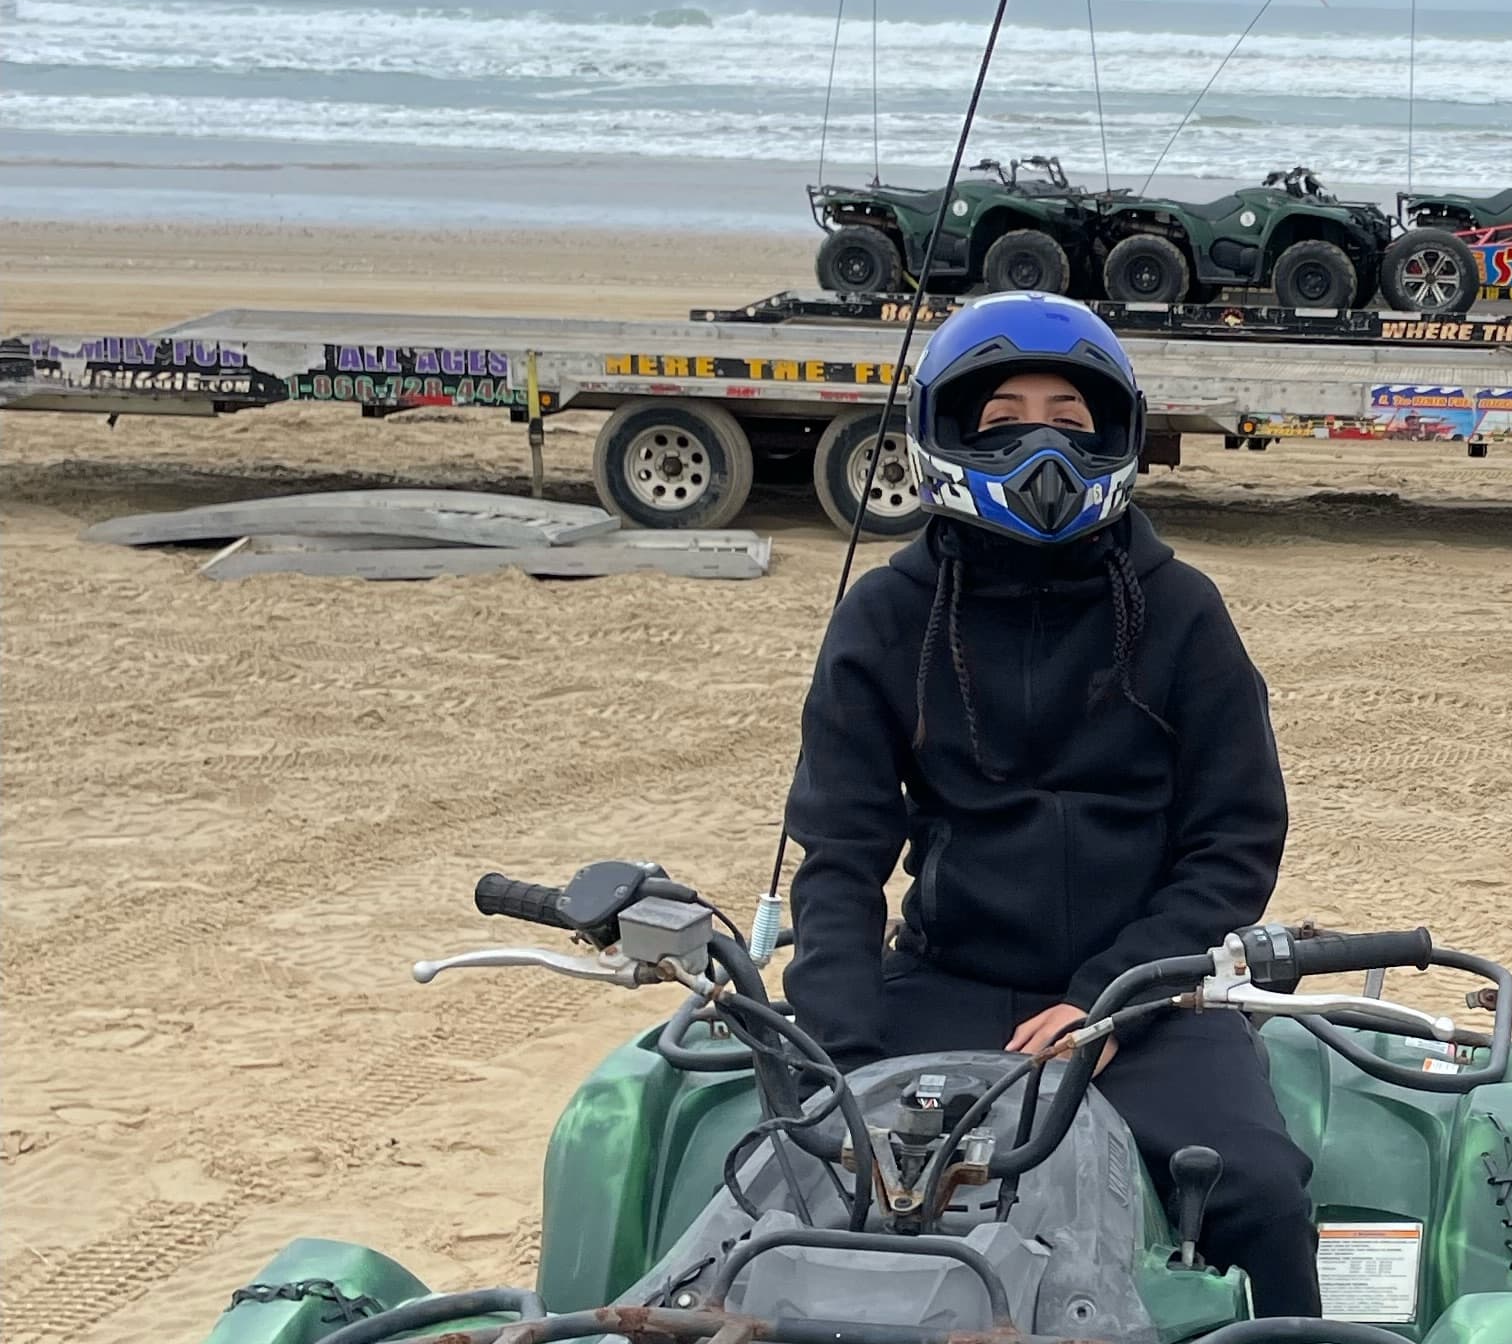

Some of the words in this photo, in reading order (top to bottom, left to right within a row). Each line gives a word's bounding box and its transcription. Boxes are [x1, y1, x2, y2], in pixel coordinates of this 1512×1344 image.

[1381, 321, 1474, 341] WHERE
[337, 345, 401, 372] ALL
[414, 349, 507, 376] AGES
[744, 359, 826, 382] THE
